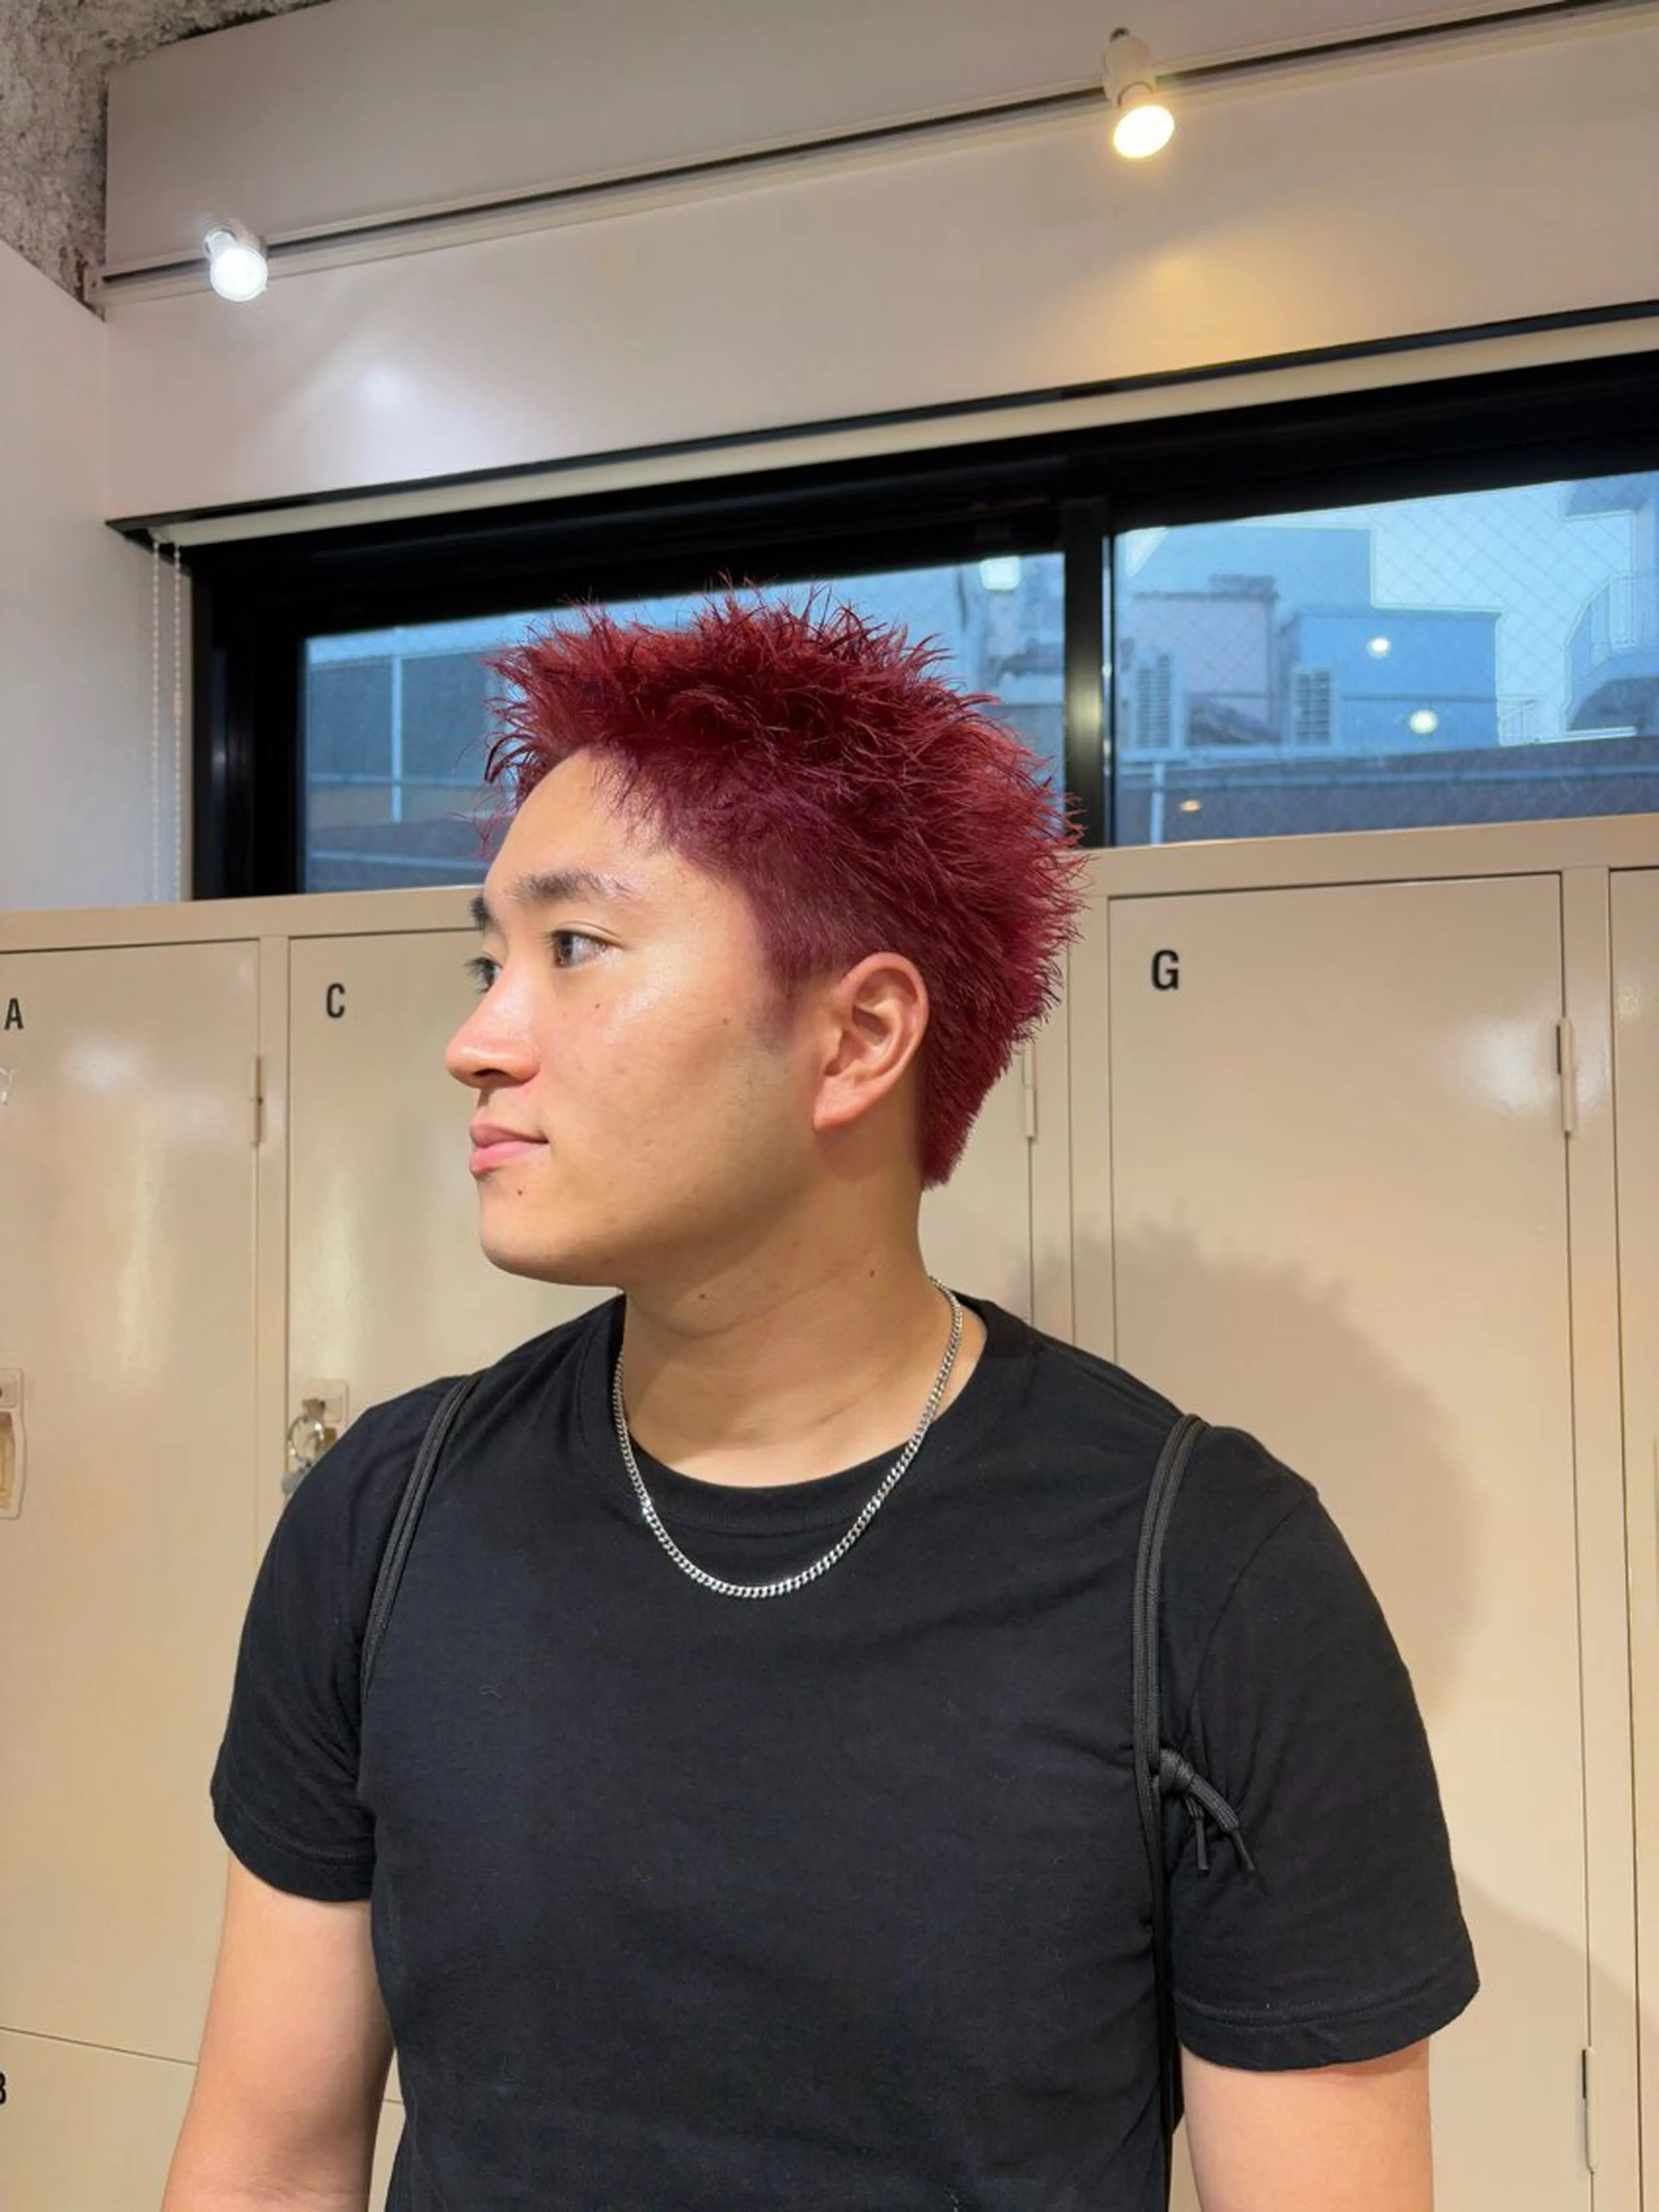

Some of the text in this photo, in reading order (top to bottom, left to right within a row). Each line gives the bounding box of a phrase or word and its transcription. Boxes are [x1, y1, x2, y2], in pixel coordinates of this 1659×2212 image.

[1151, 949, 1179, 991] G
[4, 998, 24, 1030] A
[326, 983, 345, 1019] C
